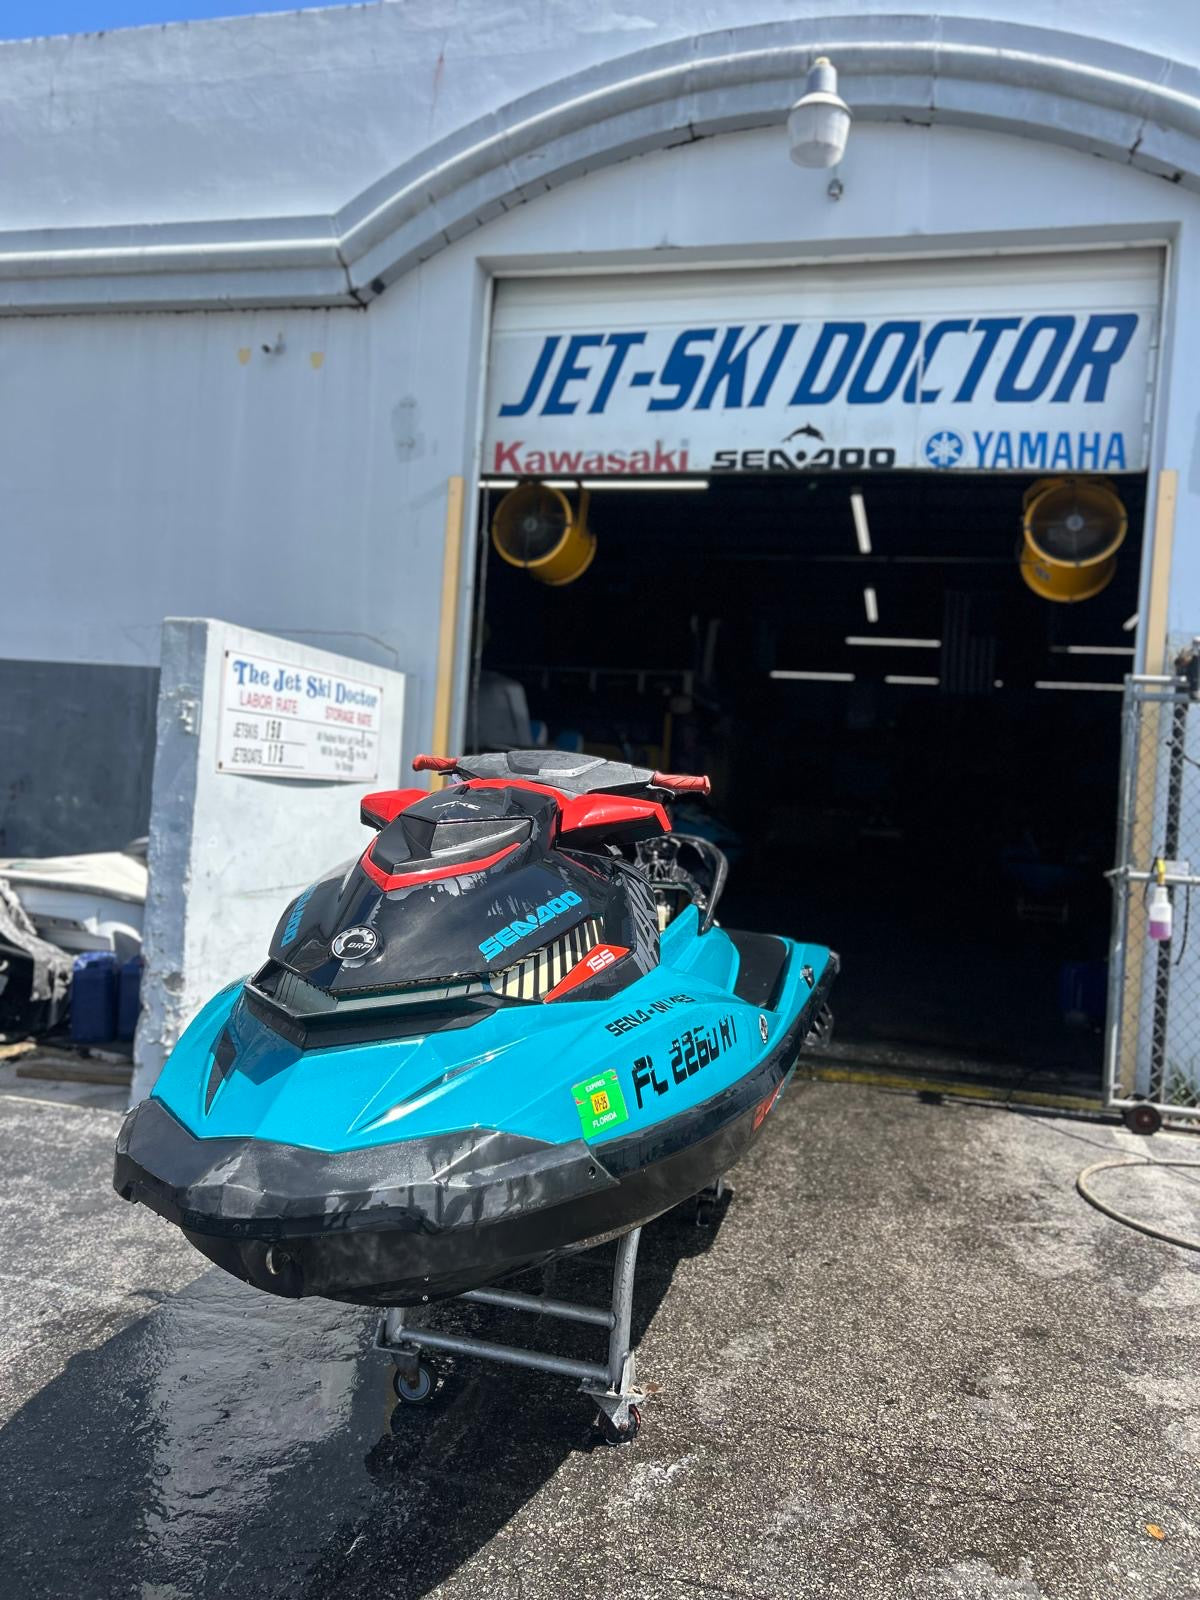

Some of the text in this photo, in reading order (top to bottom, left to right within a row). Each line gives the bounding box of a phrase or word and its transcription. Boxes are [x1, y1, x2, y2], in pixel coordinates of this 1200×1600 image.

[498, 313, 1139, 417] JET-SKI DOCTOR
[493, 440, 690, 474] Kawasaki
[972, 431, 1127, 470] YAMAHA
[233, 660, 378, 708] The Jet Ski Doctor
[240, 690, 299, 715] LABOR RATE
[347, 942, 371, 950] BRP
[586, 948, 616, 972] 155
[631, 1054, 669, 1110] FL
[592, 1111, 618, 1129] FLORIDA
